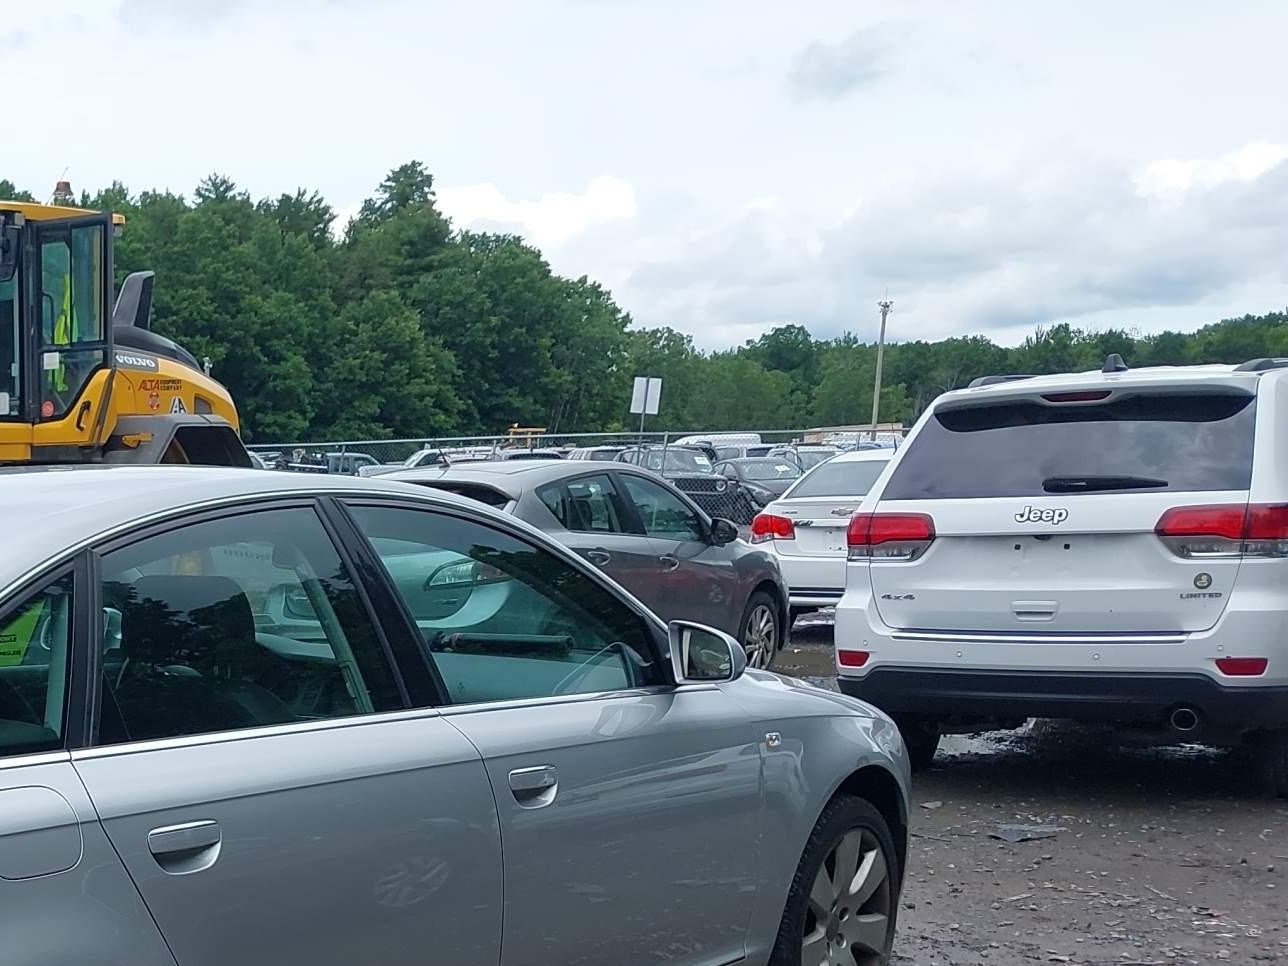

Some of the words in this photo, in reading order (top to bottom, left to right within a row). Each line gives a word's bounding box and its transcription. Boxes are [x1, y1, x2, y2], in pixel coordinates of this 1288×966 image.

[115, 354, 156, 368] VOLVO
[1015, 505, 1069, 525] Jeep
[1179, 592, 1223, 600] LIMITED
